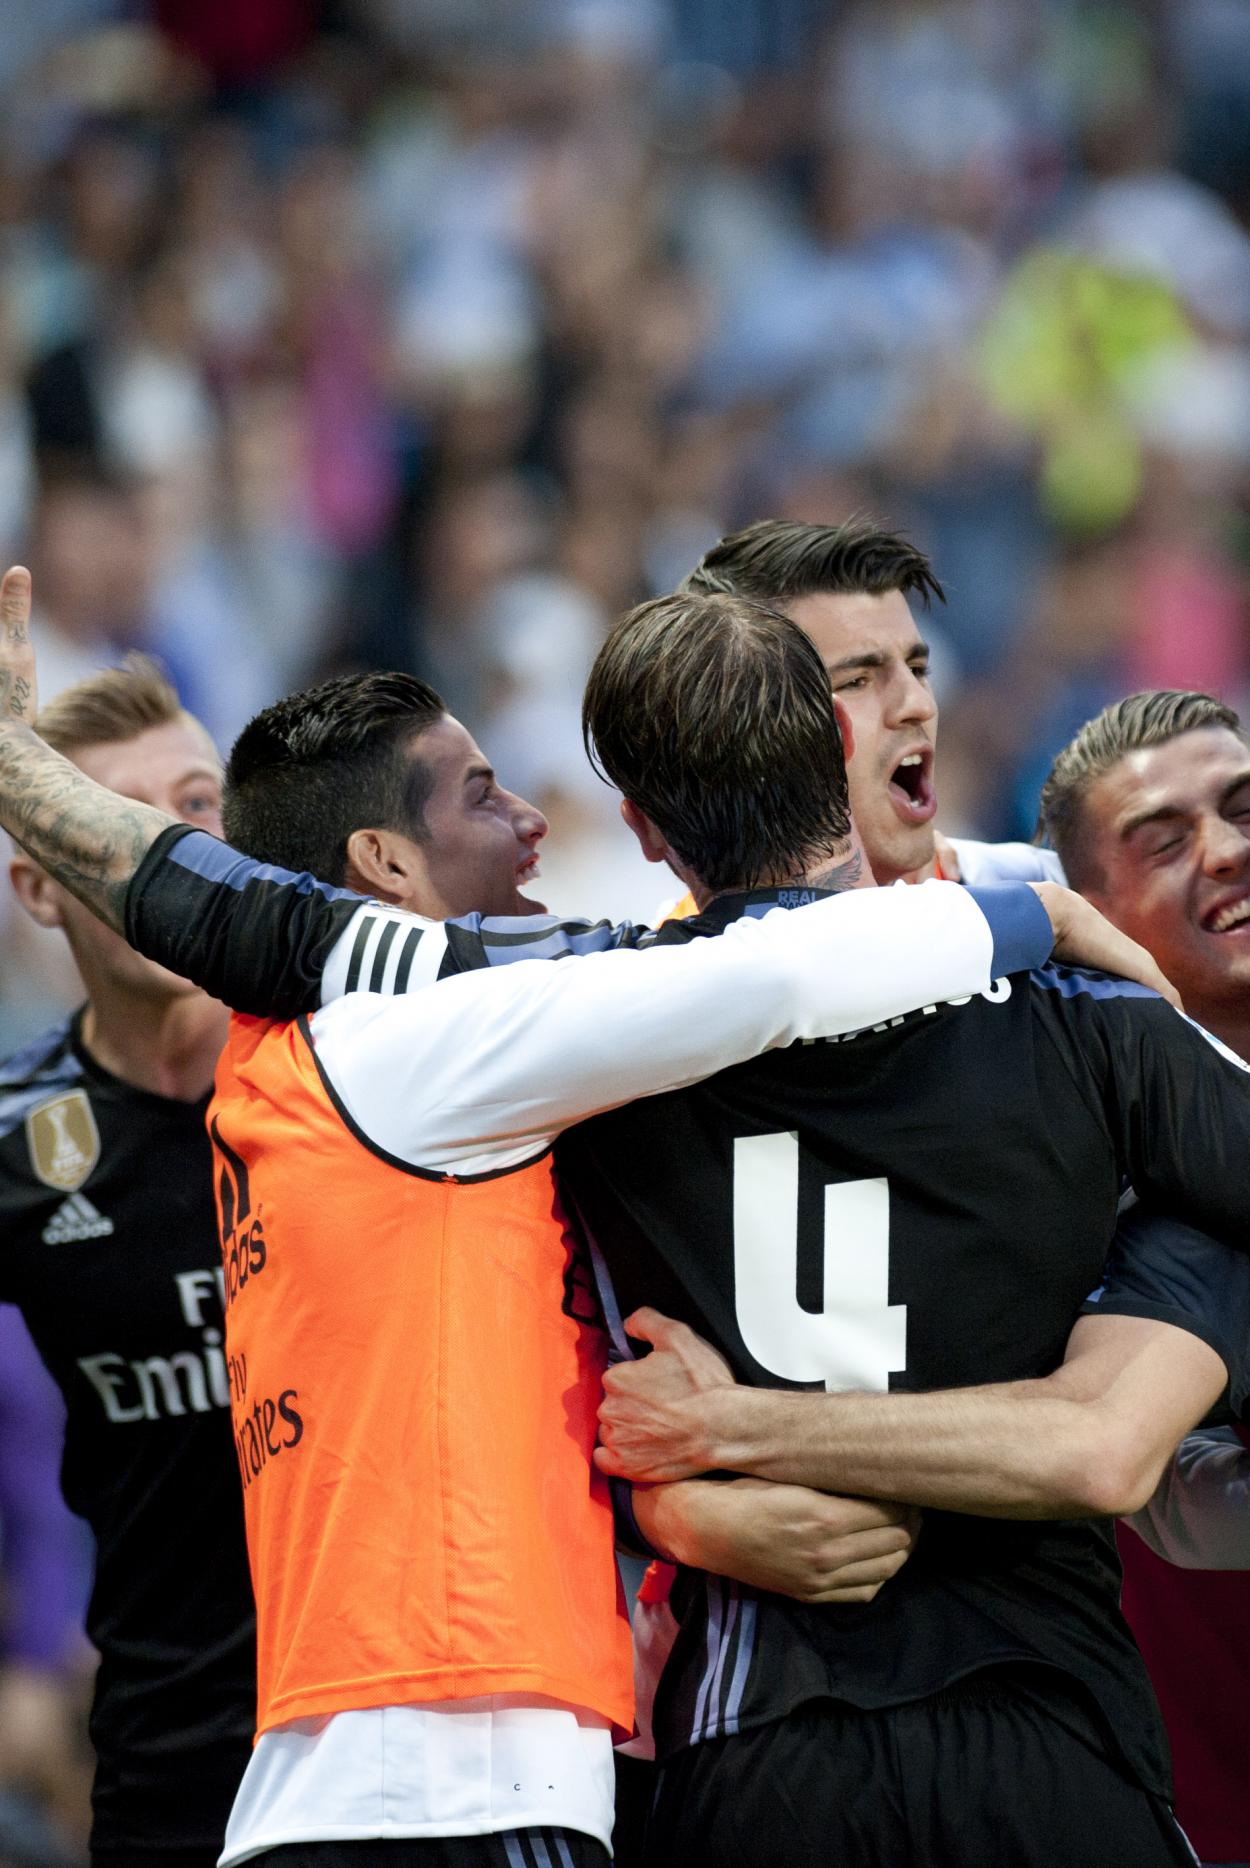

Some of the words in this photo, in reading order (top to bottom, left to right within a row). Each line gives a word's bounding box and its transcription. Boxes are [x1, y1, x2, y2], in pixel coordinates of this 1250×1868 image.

[41, 1216, 114, 1245] adidas
[733, 1131, 908, 1393] 4
[76, 1326, 231, 1423] Emi
